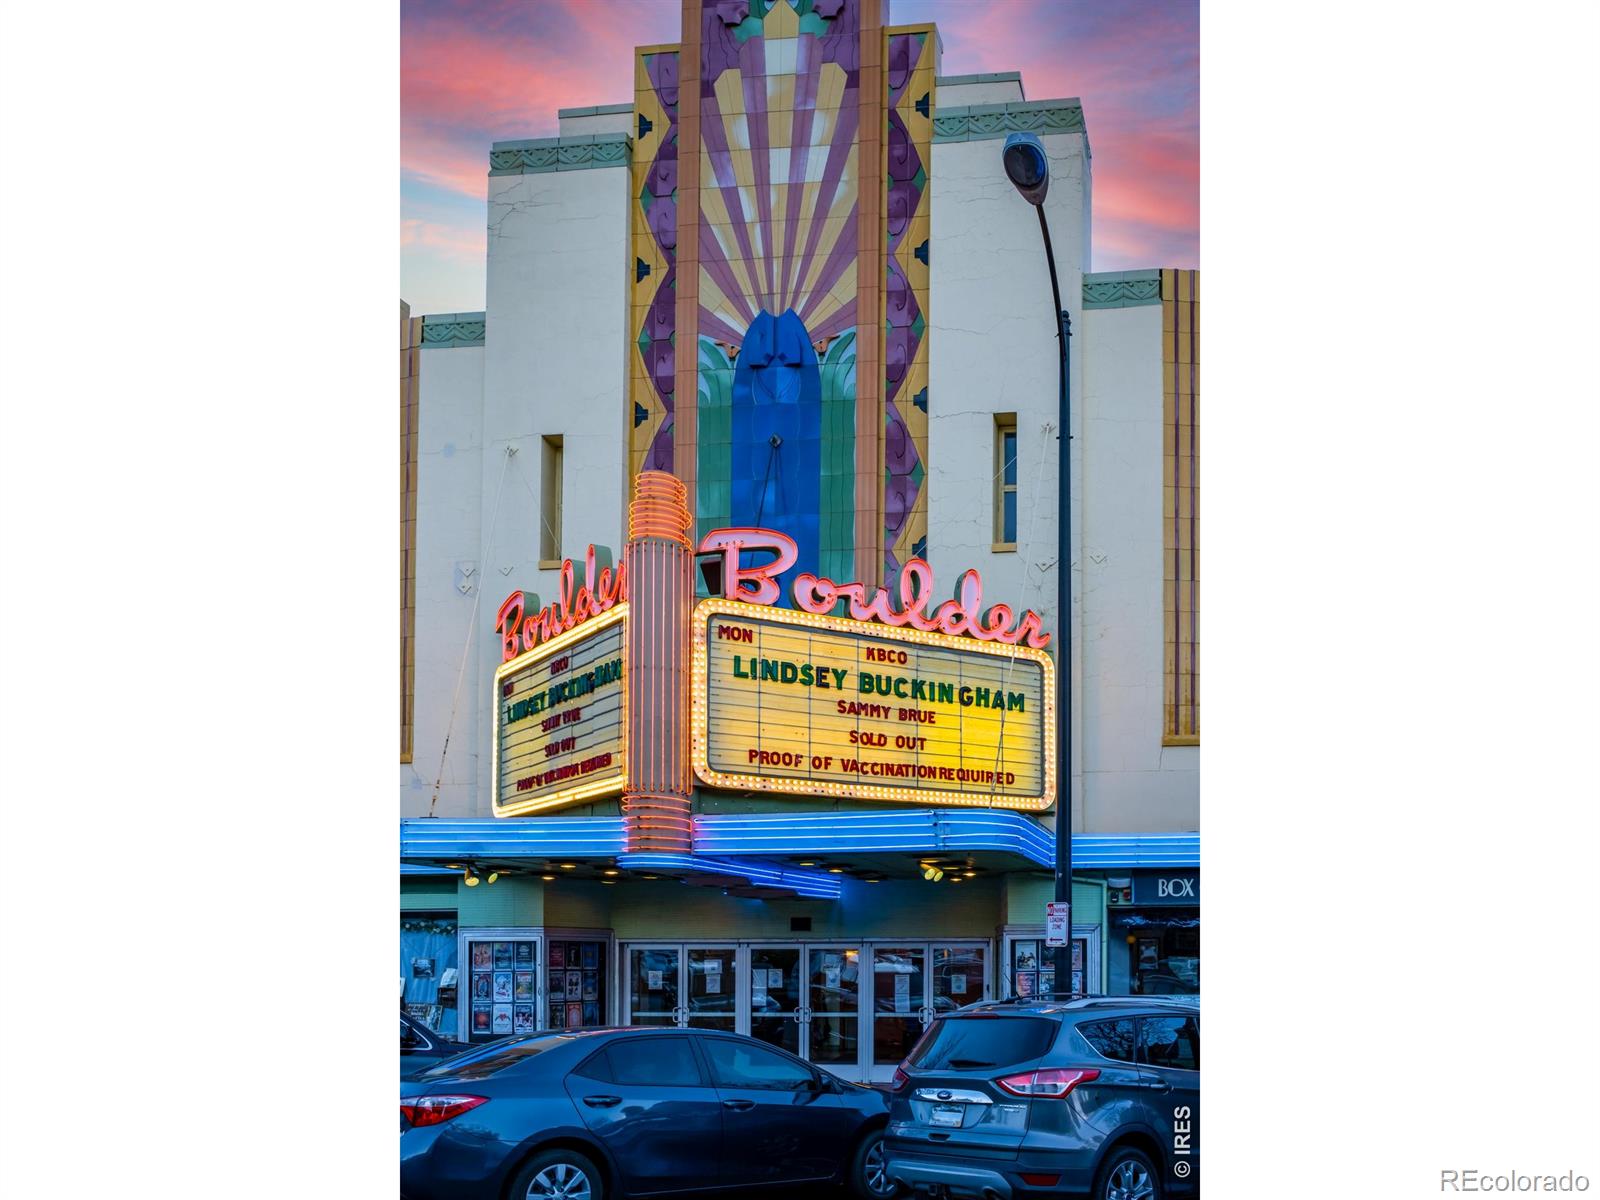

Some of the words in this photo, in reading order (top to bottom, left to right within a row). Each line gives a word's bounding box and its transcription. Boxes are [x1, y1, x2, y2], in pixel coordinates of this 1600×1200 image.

[701, 527, 1051, 649] Boulder
[717, 624, 753, 644] MON
[866, 646, 908, 665] KBCO
[733, 655, 848, 691] LINDSEY
[859, 672, 1025, 713] BUCKINGHAM
[837, 700, 891, 720] SAMMY
[898, 707, 936, 724] BRUE
[849, 730, 888, 748] SOLD
[895, 735, 928, 751] OUT
[748, 749, 803, 767] PROOF
[811, 755, 833, 771] OF
[841, 759, 938, 780] VACCINATION
[1158, 878, 1195, 898] BOX
